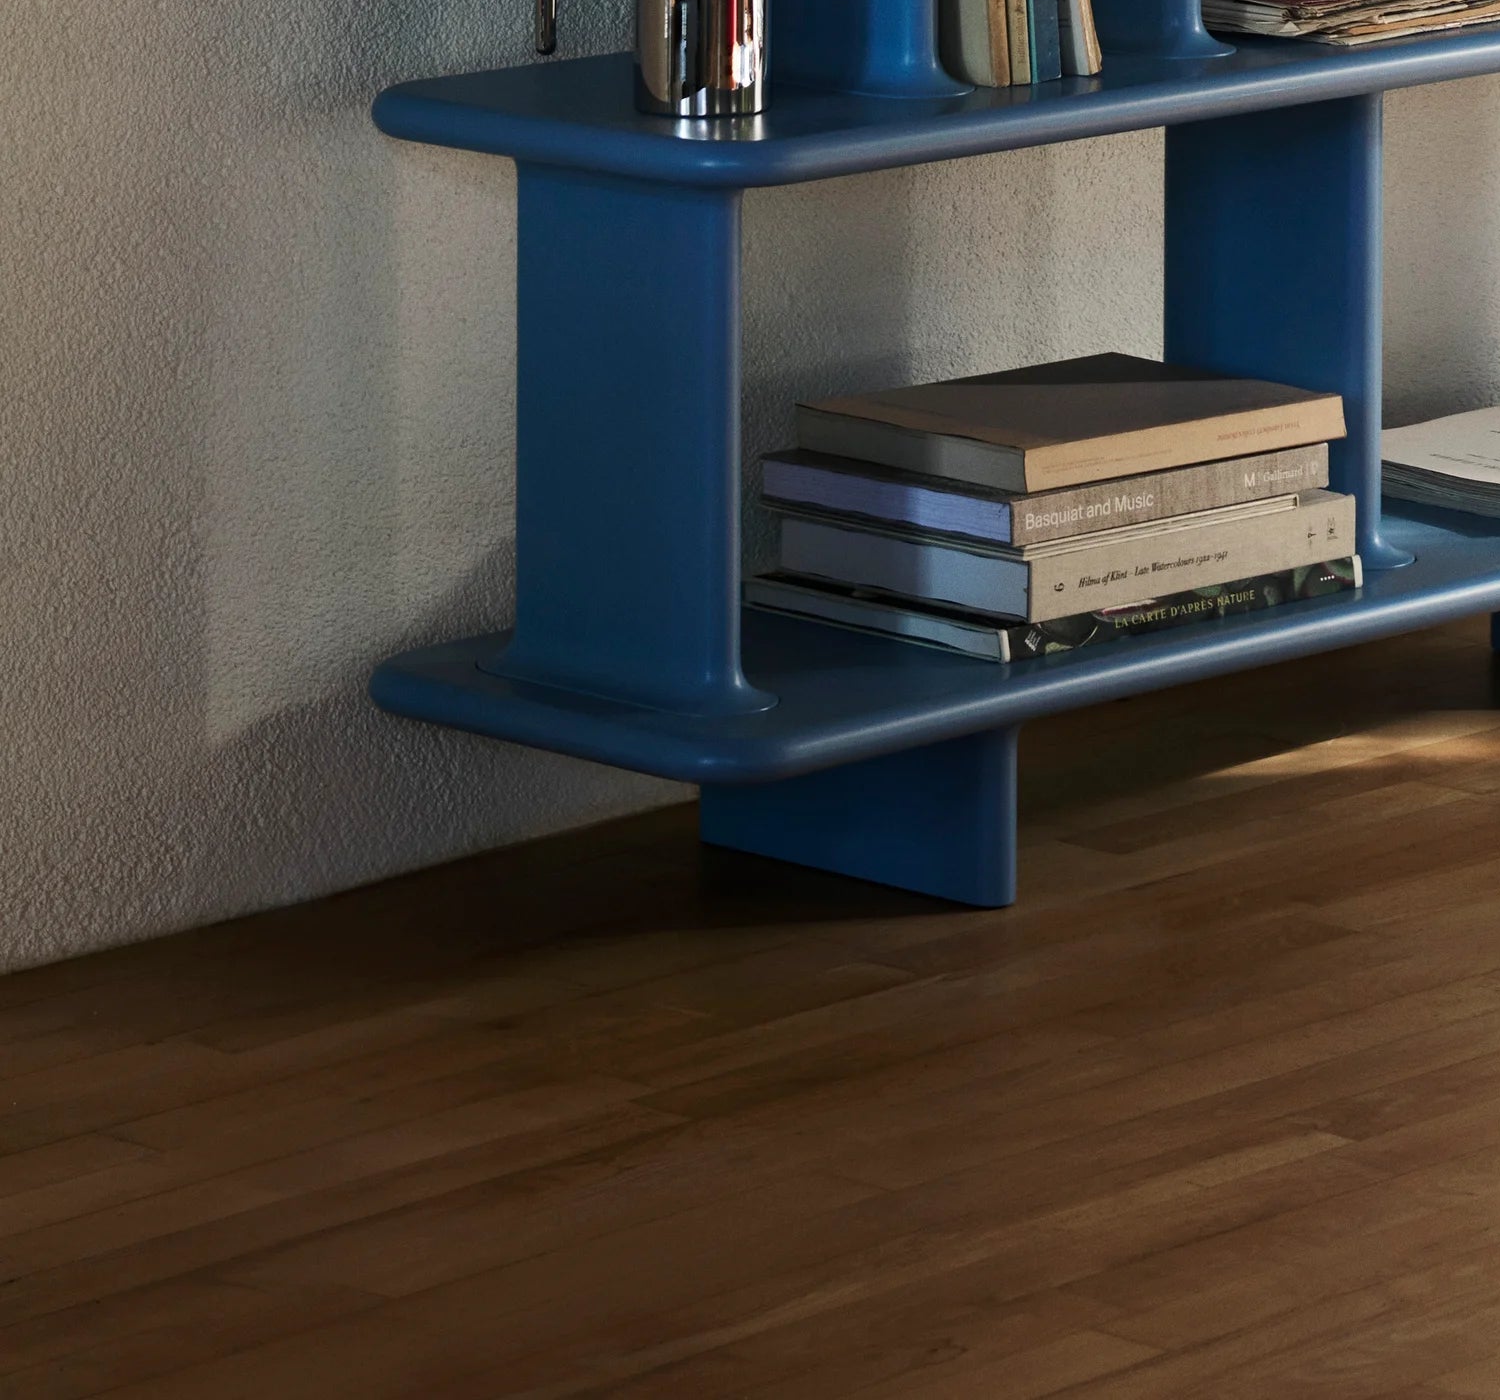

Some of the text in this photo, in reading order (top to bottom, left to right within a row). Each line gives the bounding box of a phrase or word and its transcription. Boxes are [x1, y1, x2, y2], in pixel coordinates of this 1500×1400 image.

[1244, 472, 1256, 488] M
[1263, 465, 1303, 481] Gallimard
[1025, 492, 1155, 530] Basquiat and Music
[1078, 576, 1101, 589] Hilma
[1101, 573, 1110, 586] af
[1110, 569, 1128, 583] Klint
[1134, 565, 1150, 577] Late
[1151, 557, 1195, 573] Watercolours
[1114, 617, 1129, 629] LA
[1131, 609, 1167, 626] CARTE
[1217, 589, 1256, 608] NATURE
